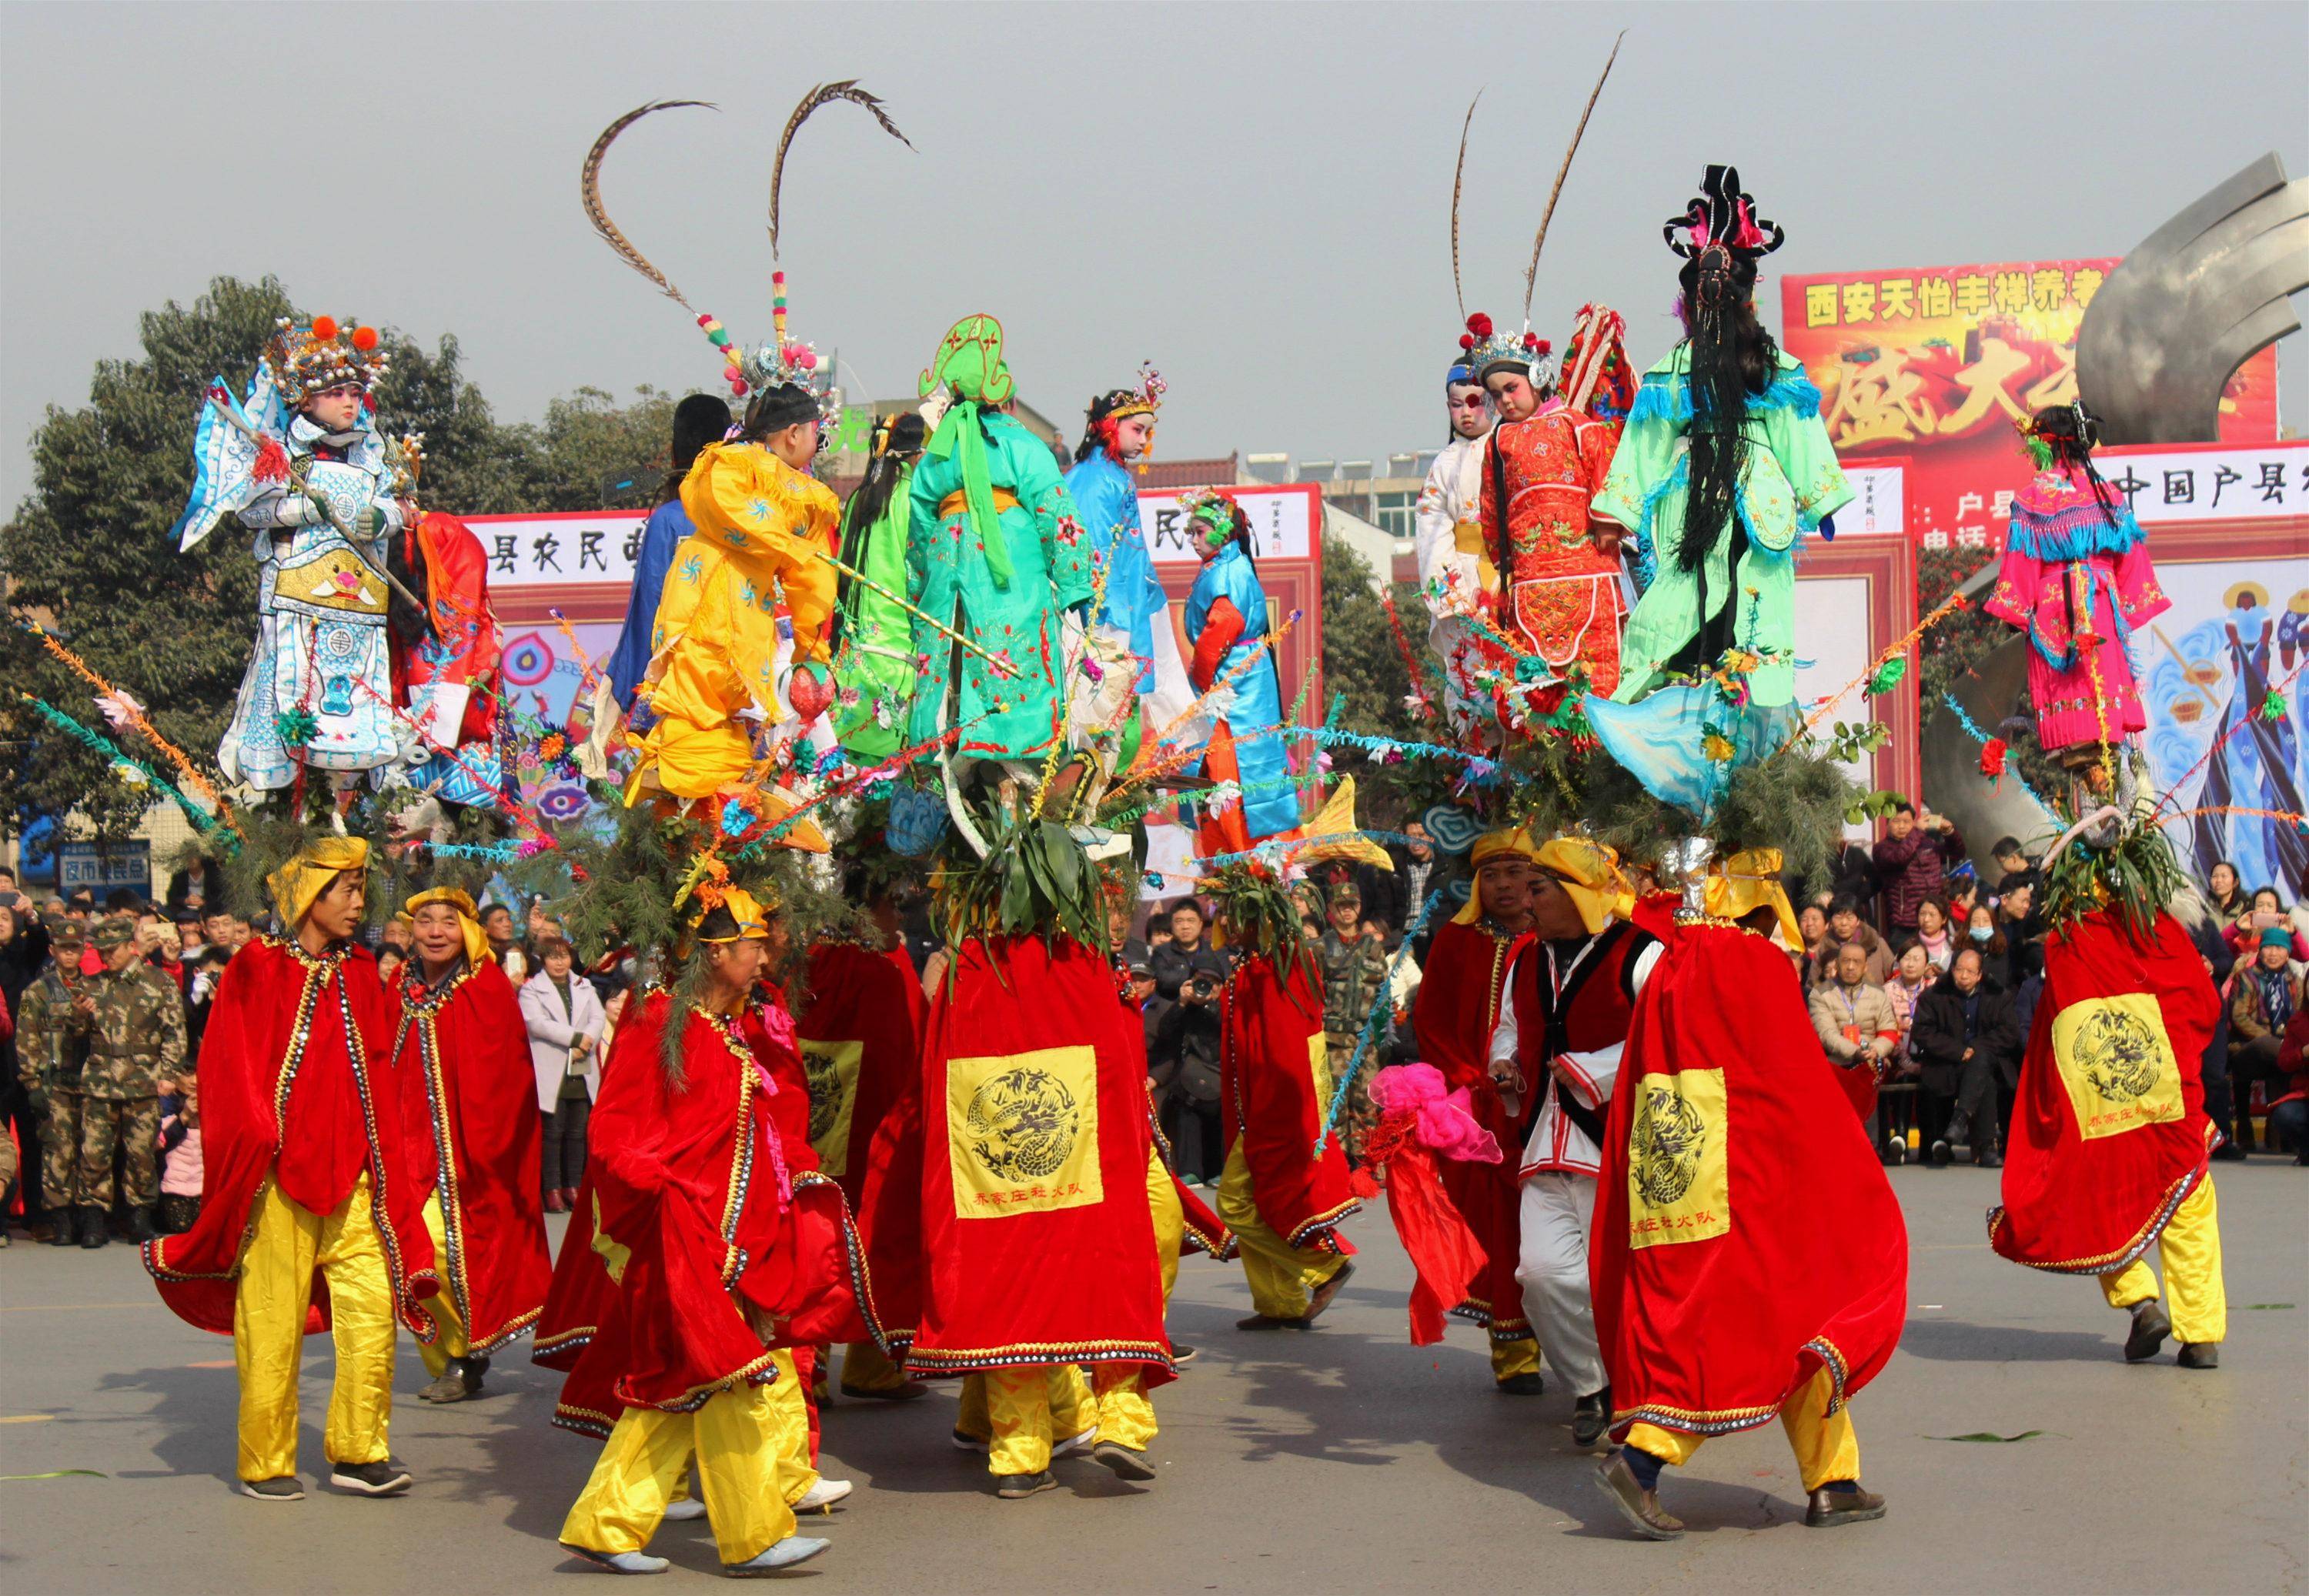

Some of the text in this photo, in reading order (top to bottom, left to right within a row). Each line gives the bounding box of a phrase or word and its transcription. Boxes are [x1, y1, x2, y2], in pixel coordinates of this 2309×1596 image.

[2111, 462, 2309, 511] 中国户县
[1155, 509, 1184, 551] 民
[974, 1183, 1083, 1205] 乔家庄社火队
